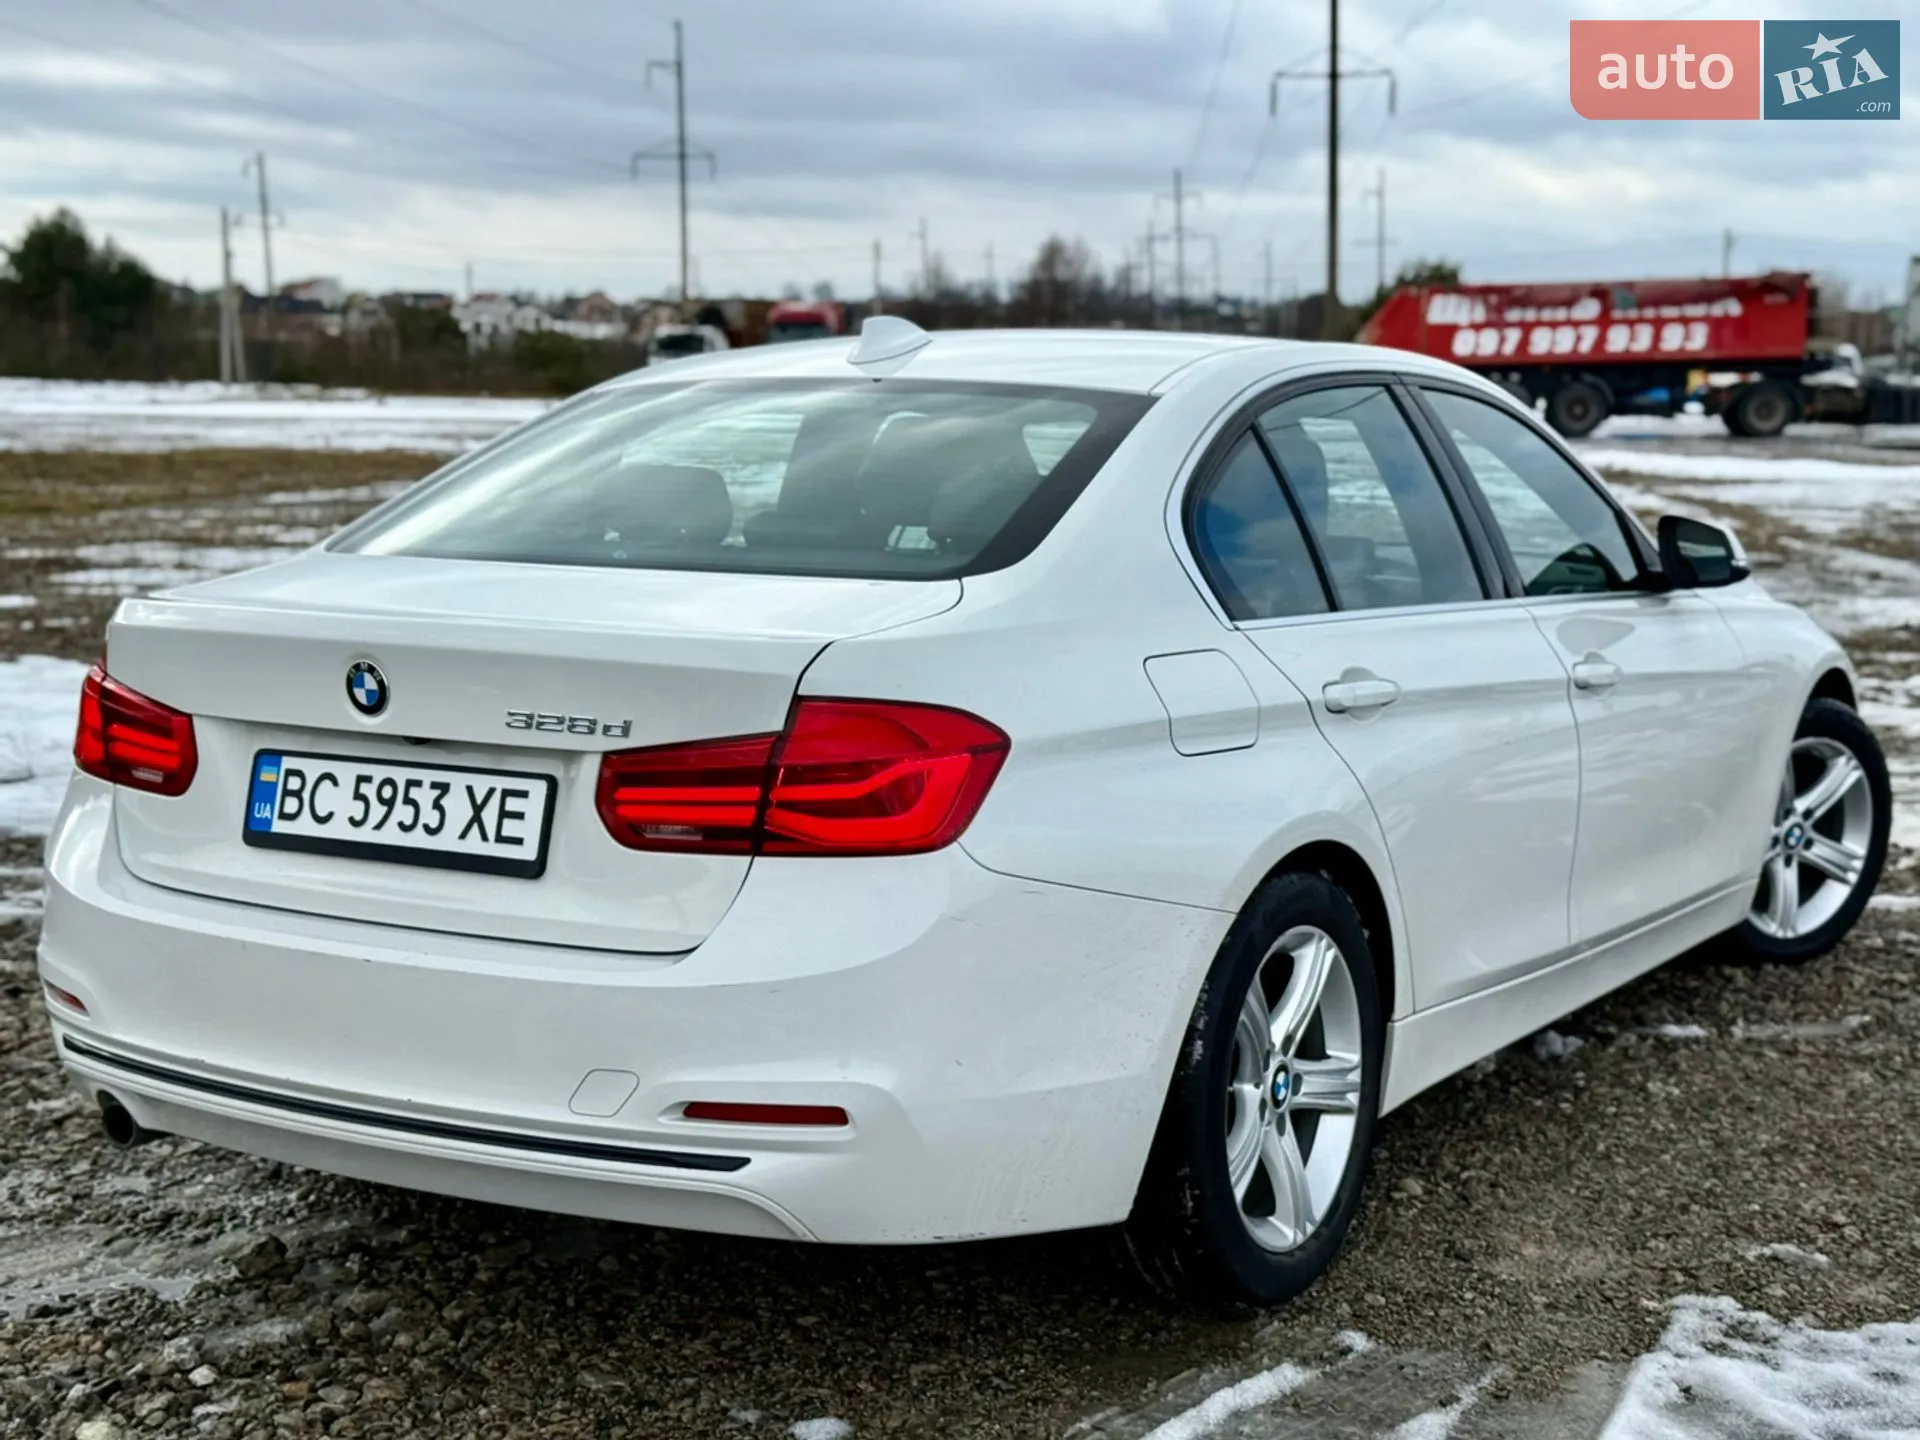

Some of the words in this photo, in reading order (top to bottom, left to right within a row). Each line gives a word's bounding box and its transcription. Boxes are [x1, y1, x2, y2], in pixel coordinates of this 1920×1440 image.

[1451, 327, 1523, 357] 097
[1528, 324, 1600, 355] 997
[504, 709, 633, 739] 328d
[254, 801, 272, 820] UA
[277, 768, 339, 824] BC
[347, 773, 450, 837] 5953
[458, 784, 530, 846] XE
